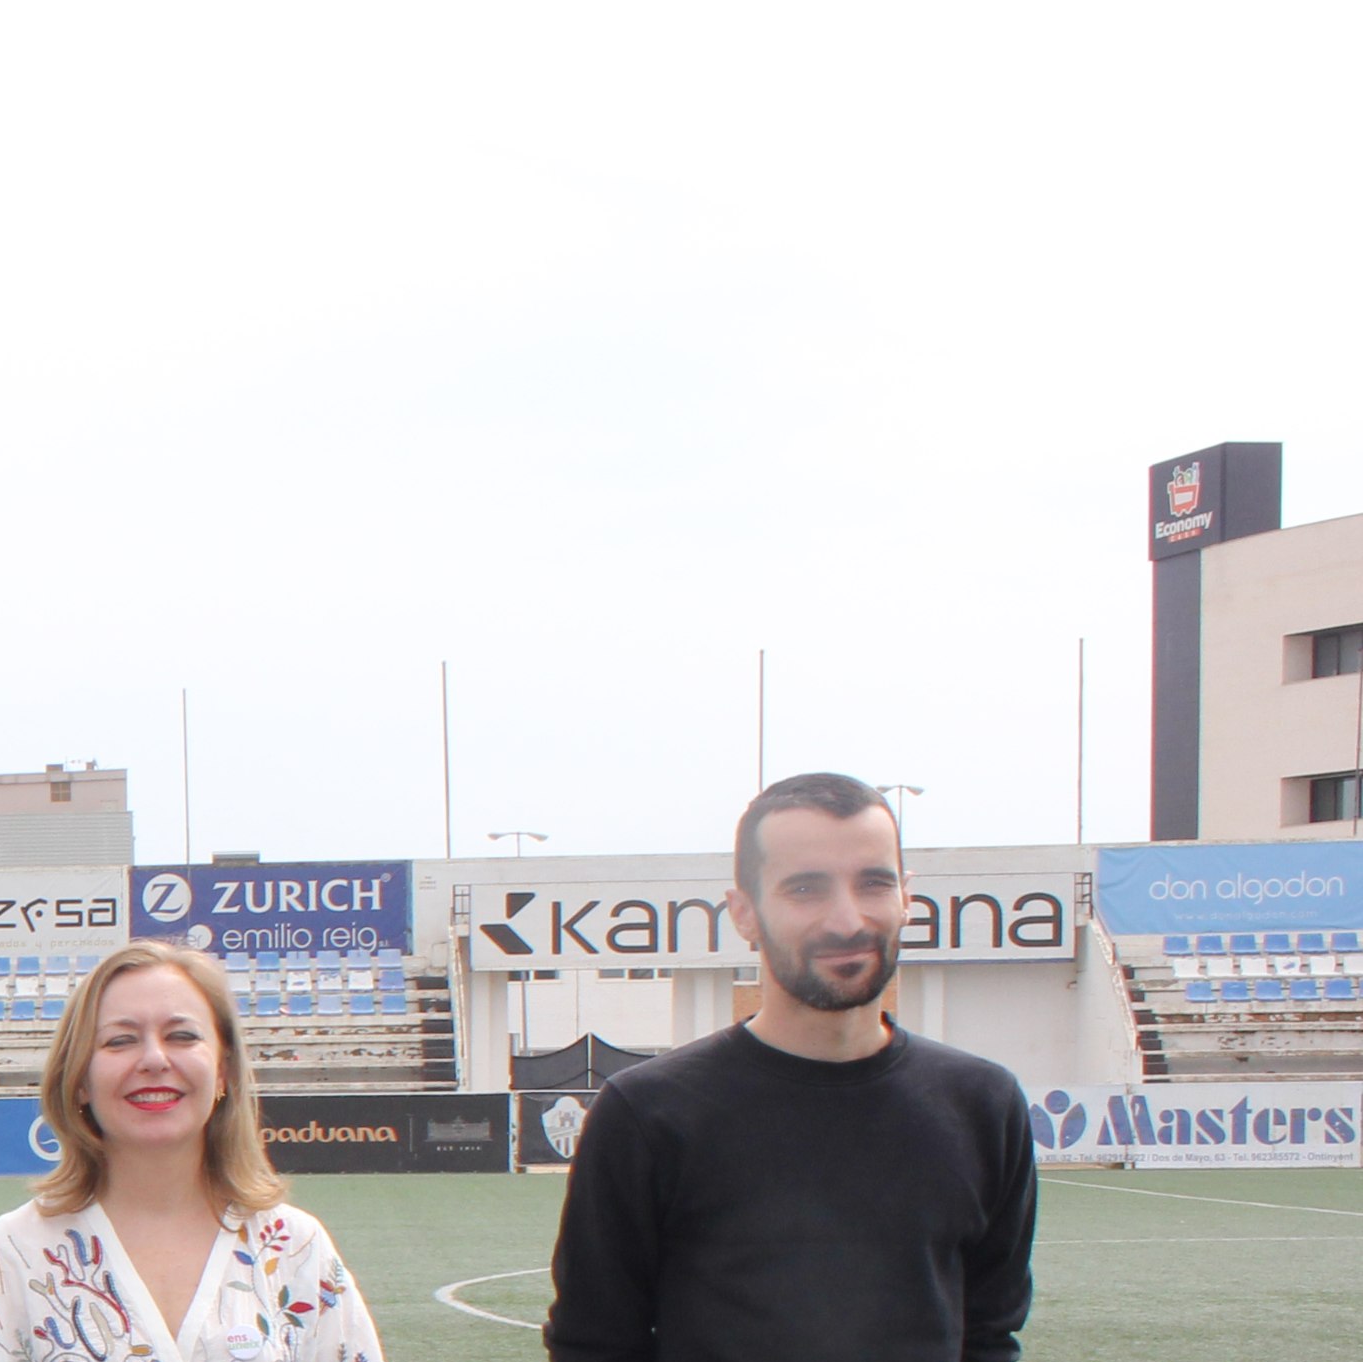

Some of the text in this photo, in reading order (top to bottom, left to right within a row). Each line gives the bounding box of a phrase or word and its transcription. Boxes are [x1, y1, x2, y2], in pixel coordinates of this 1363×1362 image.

[1155, 510, 1213, 540] Economy
[211, 878, 383, 914] ZURICH
[1149, 869, 1345, 905] don algodon
[222, 922, 313, 950] emilio
[322, 922, 378, 953] reig
[1096, 1095, 1356, 1146] Masters
[1151, 1152, 1167, 1162] Dos
[1170, 1152, 1183, 1162] de
[1233, 1152, 1249, 1162] Tel.
[1307, 1151, 1354, 1163] Ontinyent
